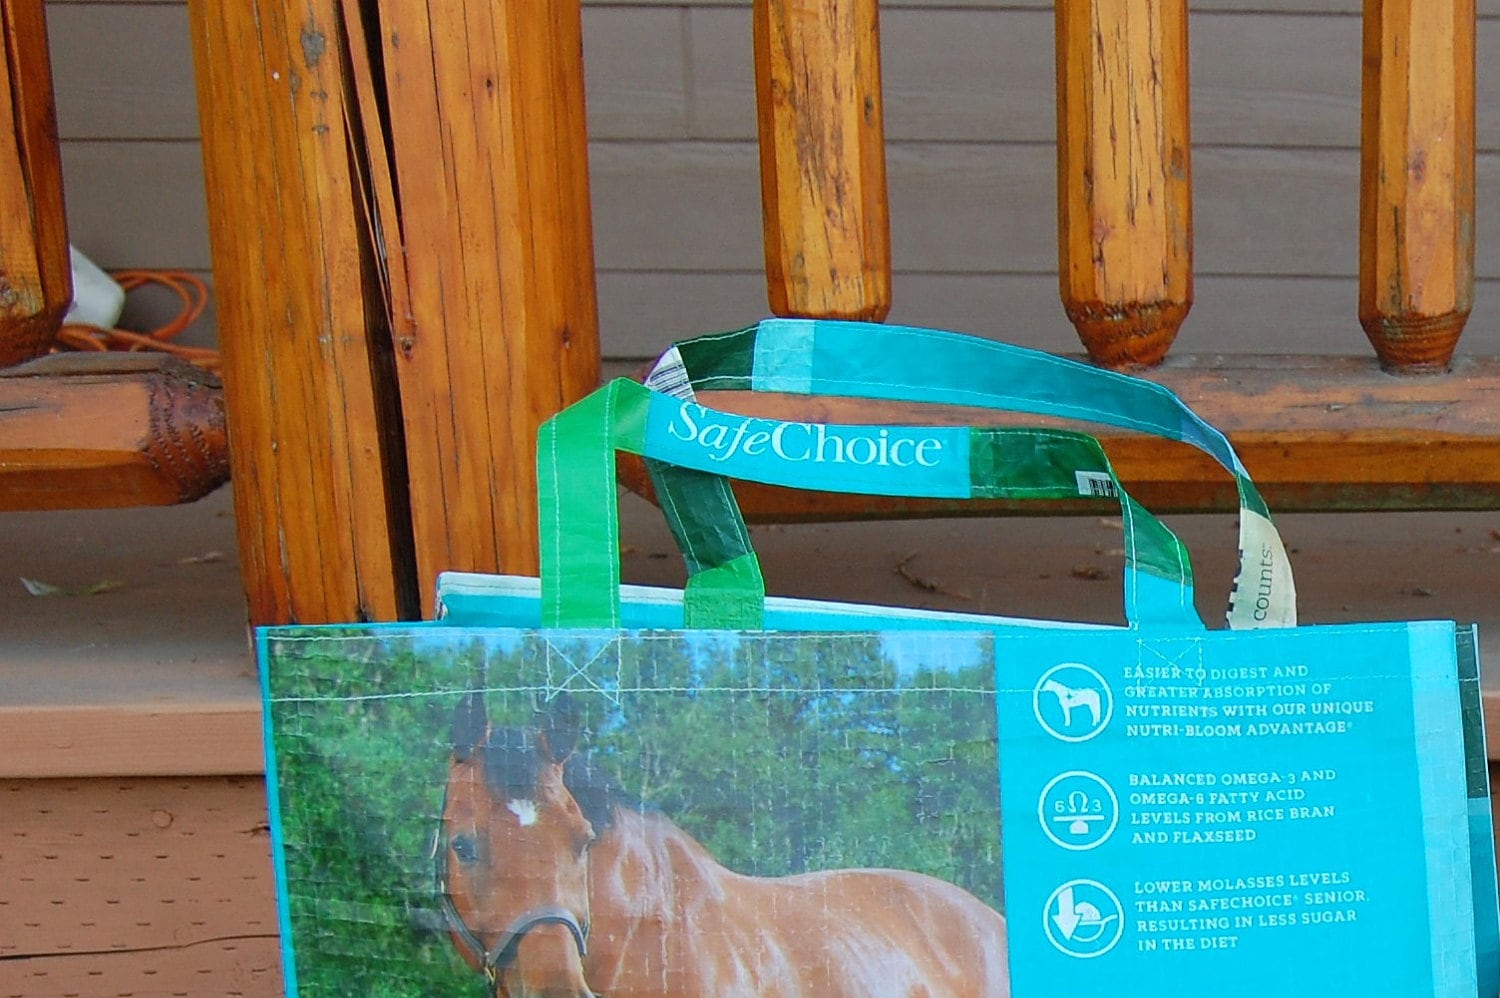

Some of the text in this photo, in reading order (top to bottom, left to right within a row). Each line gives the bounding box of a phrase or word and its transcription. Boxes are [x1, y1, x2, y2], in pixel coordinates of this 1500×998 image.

[668, 400, 942, 467] SafeChoice
[1124, 665, 1308, 681] EASIER TO DIGEST AND
[1124, 683, 1332, 699] GREATER ABSORPTION OF
[1125, 701, 1374, 718] NUTRIENTS WITH OUR UNIQUE
[1127, 724, 1241, 737] NUTRI-BLOOM
[1129, 773, 1217, 786] BALANCED
[1301, 769, 1336, 781] AND
[1129, 789, 1305, 805] OMEGA-6 FATTY ACID
[1131, 806, 1335, 825] LEVELS FROM RICE BRAN
[1131, 829, 1256, 844] AND FLAXSEED
[1134, 871, 1350, 895] LOWER MOLASSES LEVELS
[1135, 900, 1183, 913] THAN
[1136, 910, 1357, 932] RESULTING IN LESS SUGAR
[1138, 936, 1238, 951] IN THE DIET
